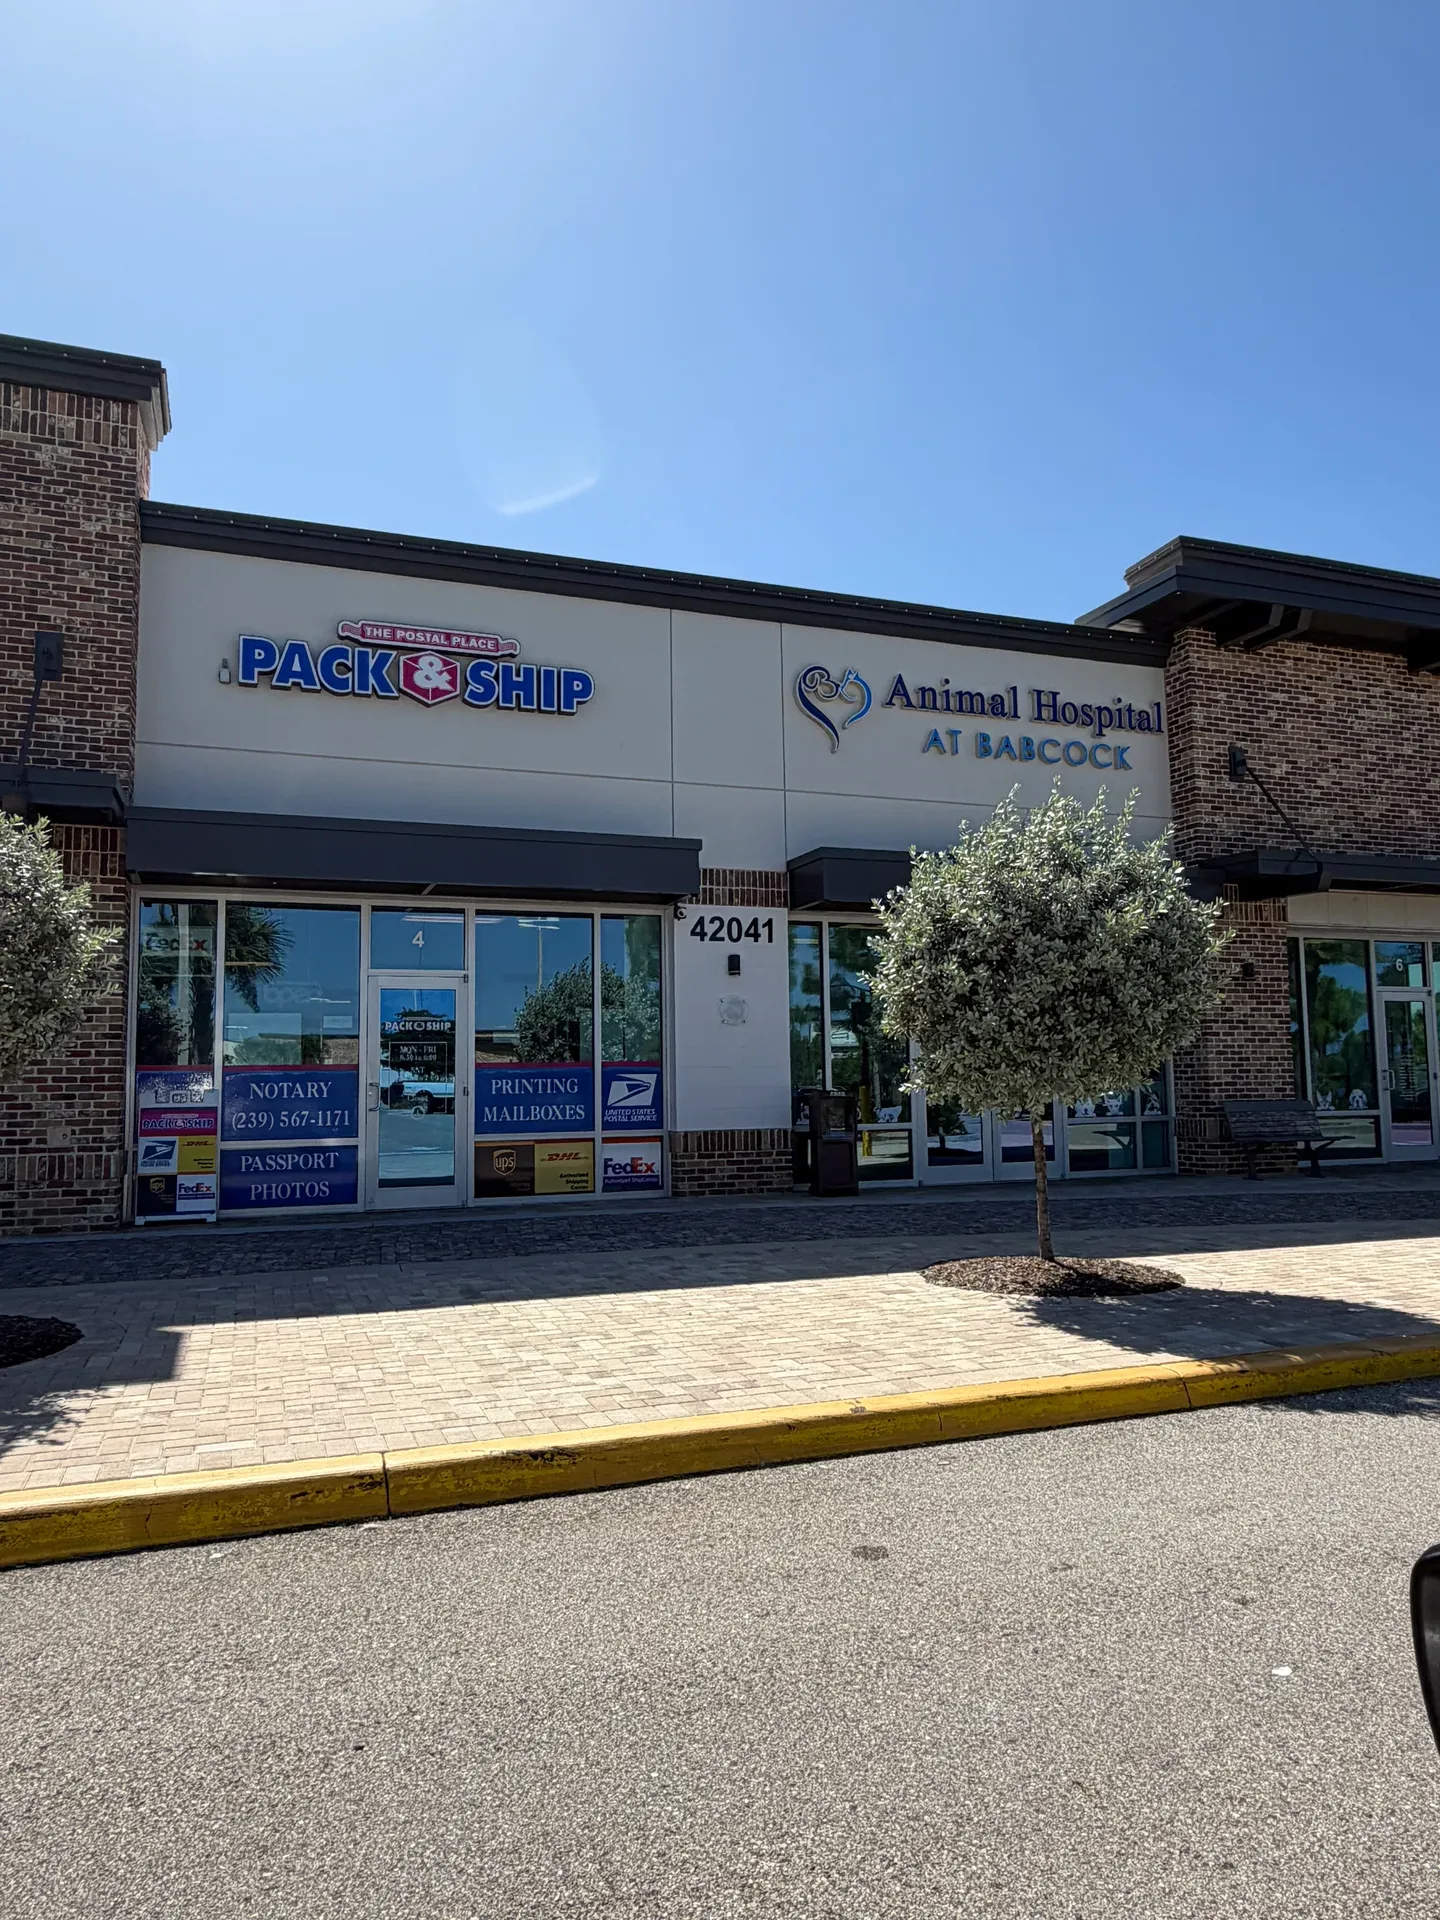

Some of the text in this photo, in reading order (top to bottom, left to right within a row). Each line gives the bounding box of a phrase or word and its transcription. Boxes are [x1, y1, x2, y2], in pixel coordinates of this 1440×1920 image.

[364, 626, 497, 651] THE POSTAL PLACE
[239, 634, 595, 716] PACK & SHIP
[884, 673, 1165, 738] Animal Hospital
[923, 728, 1133, 770] AT BABCOCK
[690, 916, 773, 943] 42041
[412, 930, 425, 948] 4
[1395, 959, 1404, 972] 6
[385, 1021, 413, 1032] PACK
[426, 1021, 452, 1032] SHIP
[249, 1081, 332, 1099] NOTARY
[491, 1078, 578, 1095] PRINTING
[232, 1110, 350, 1131] (239) 567-1171
[483, 1104, 586, 1122] MAILBOXES
[630, 1114, 657, 1122] SERVICE
[142, 1118, 171, 1129] PACK
[187, 1118, 215, 1129] SHIP
[240, 1152, 340, 1172] PASSPORT
[495, 1156, 515, 1172] ups
[547, 1152, 581, 1162] DHL
[604, 1157, 656, 1175] FedEx
[178, 1182, 213, 1193] FedEx
[250, 1181, 330, 1201] PHOTOS
